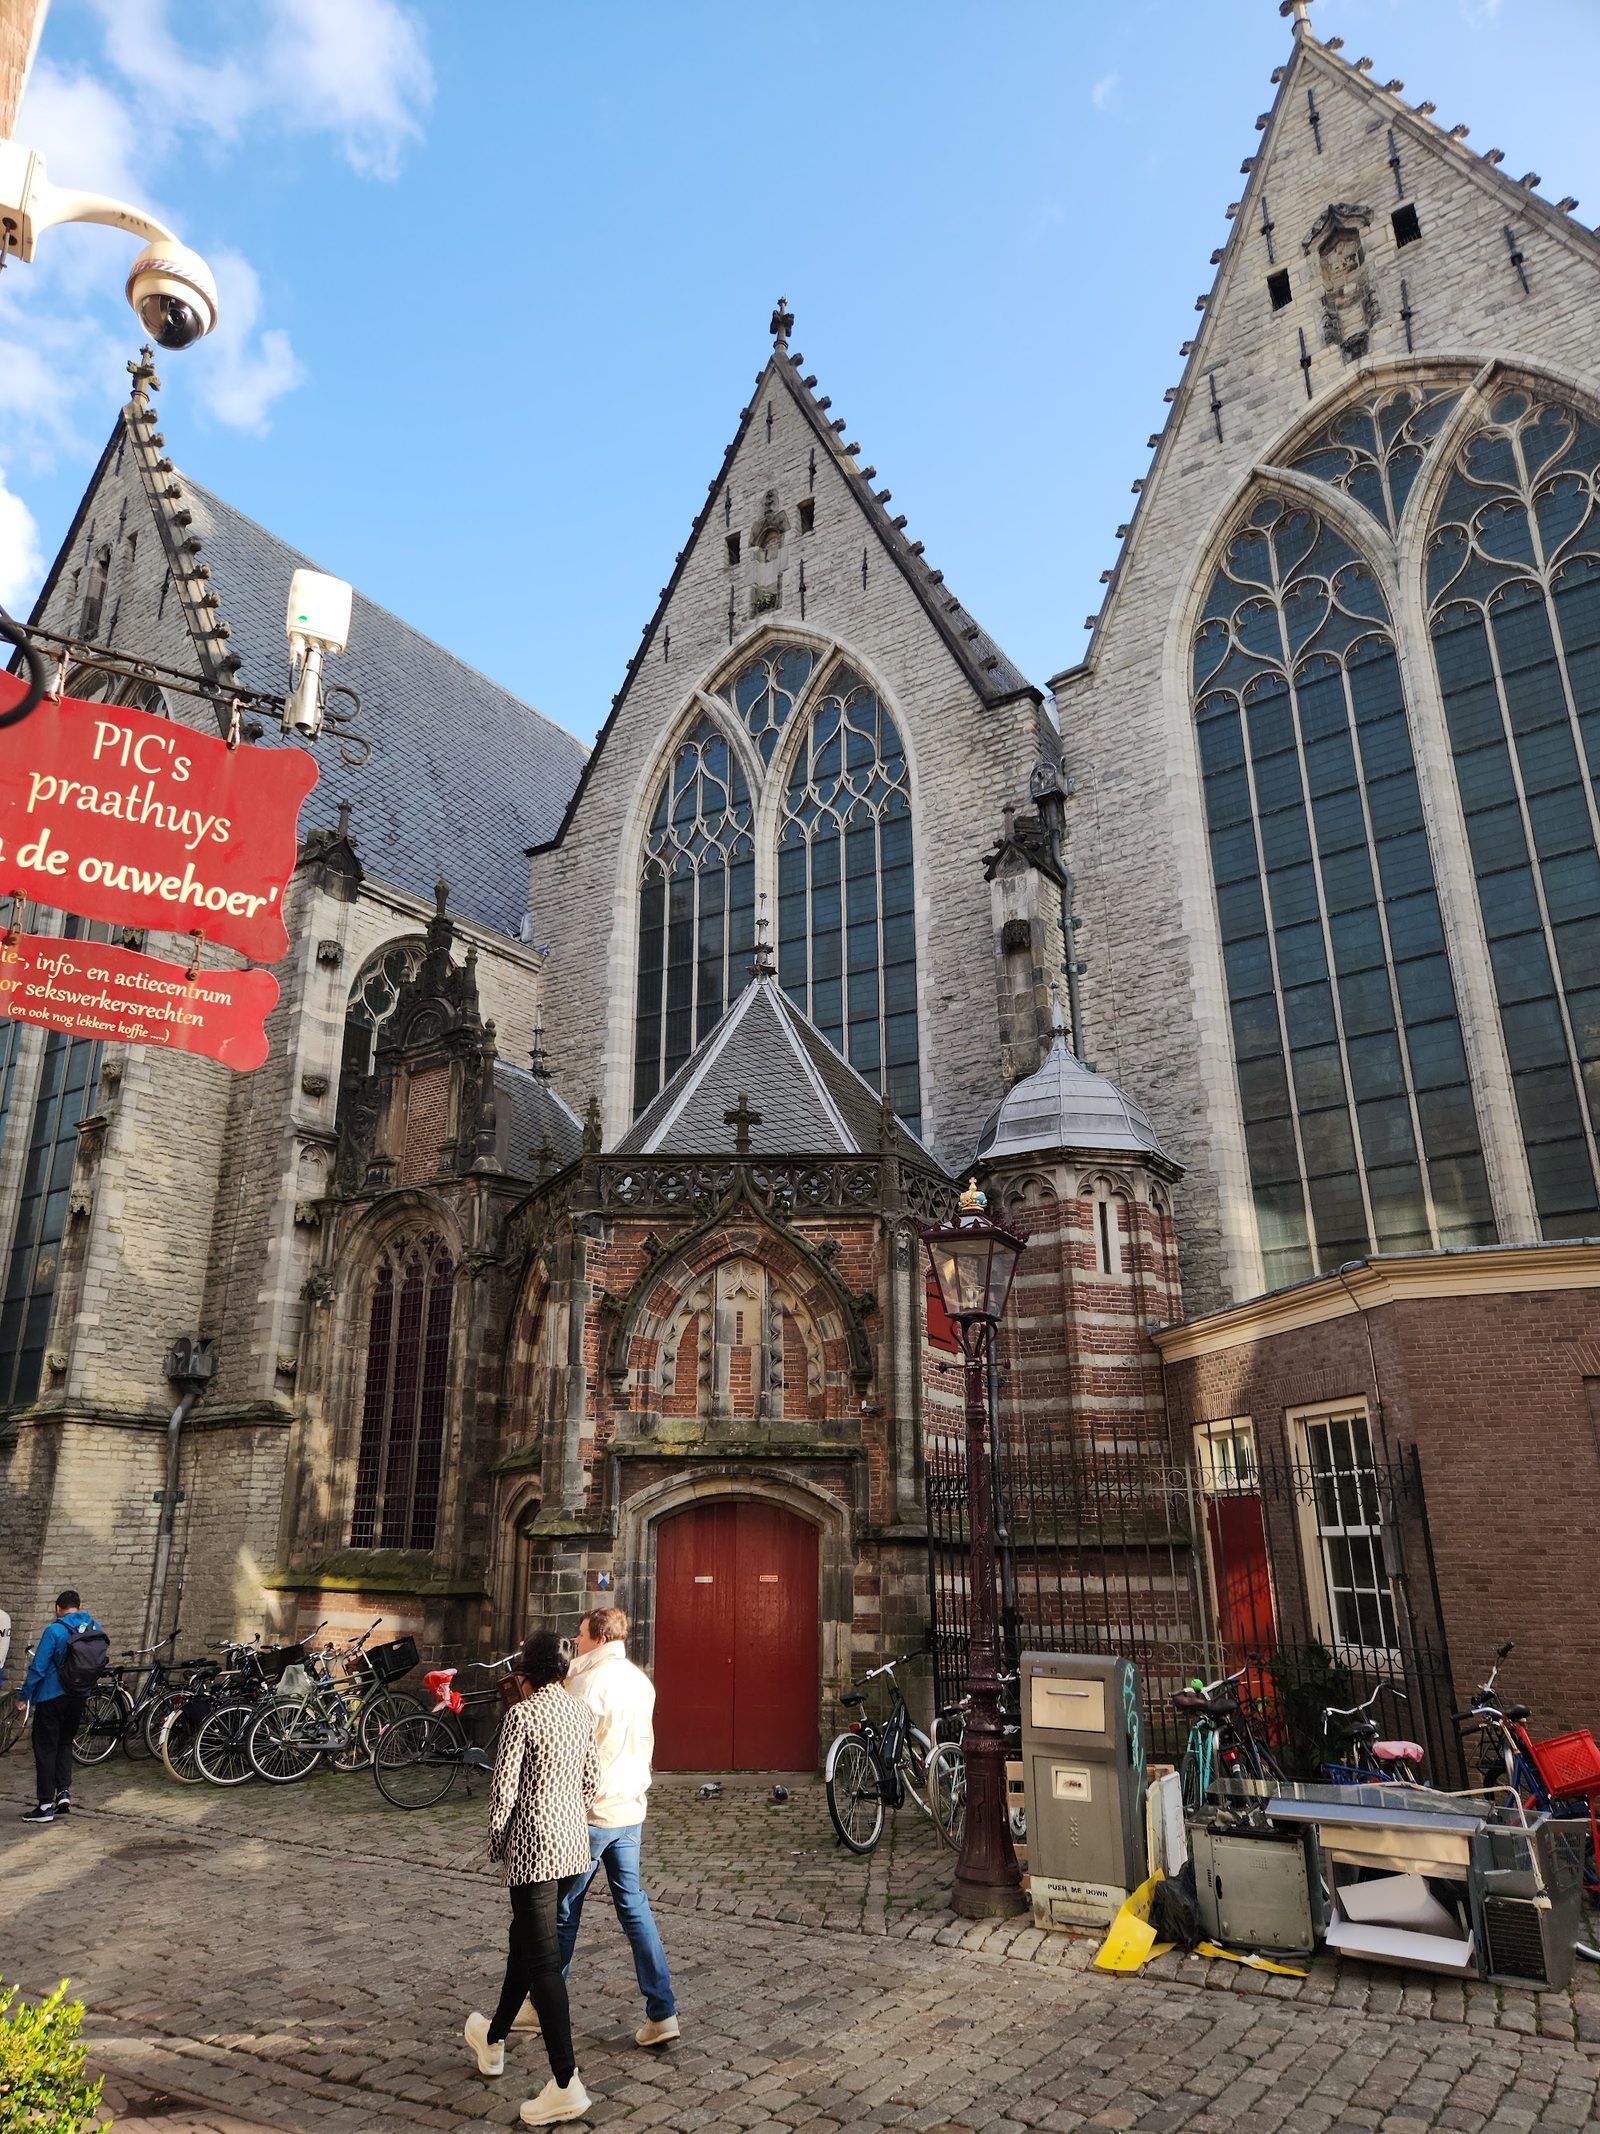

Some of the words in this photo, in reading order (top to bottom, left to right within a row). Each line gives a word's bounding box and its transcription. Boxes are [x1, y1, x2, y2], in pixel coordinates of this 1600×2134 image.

[93, 721, 192, 781] PIC's
[26, 772, 231, 850] praathuys
[16, 828, 70, 875] de
[78, 858, 279, 918] ouwehoer'
[25, 979, 204, 1027] sekswerkersrechten
[36, 952, 82, 979] info-
[86, 967, 110, 983] en
[114, 972, 232, 1005] actiecentrum
[8, 1001, 26, 1016] (en
[28, 1007, 49, 1020] ook
[52, 1013, 74, 1028] nog
[76, 1013, 116, 1033] lekkere
[117, 1021, 149, 1039] koffie
[1047, 1883, 1068, 1892] PUSH
[1070, 1886, 1082, 1894] ME
[1085, 1888, 1108, 1898] DOWN
